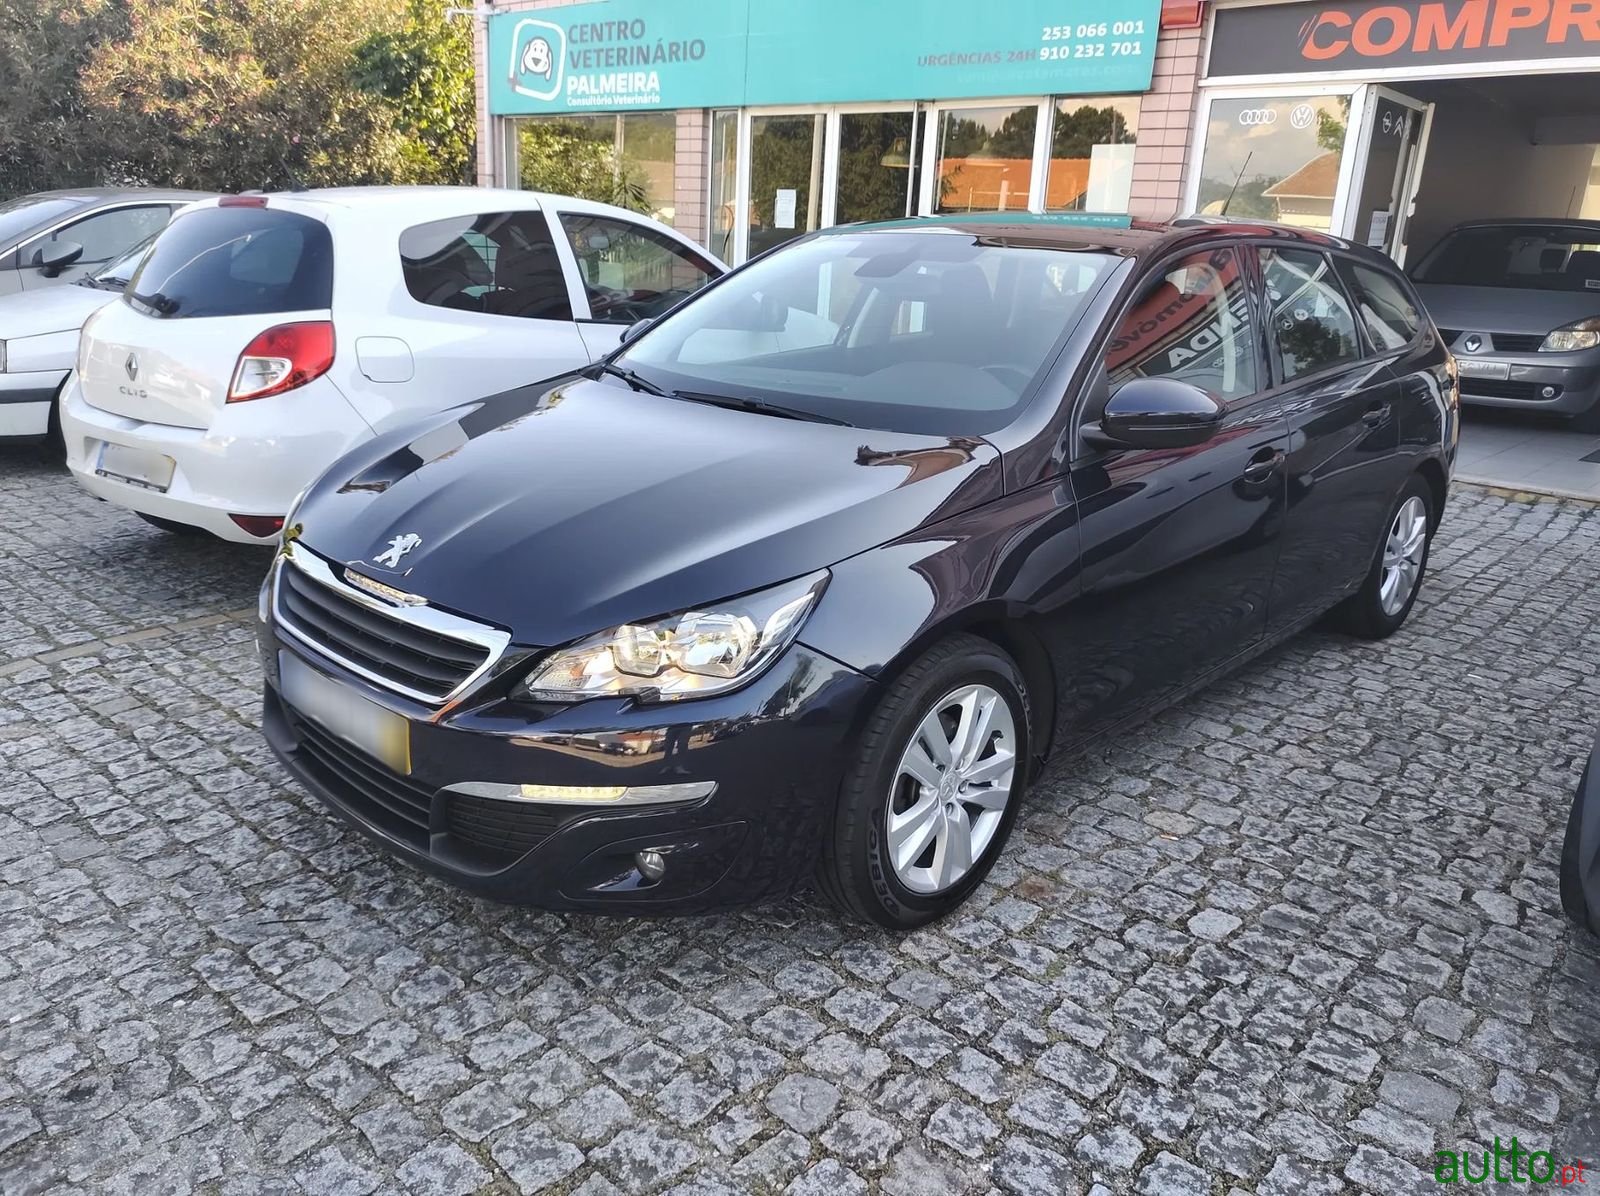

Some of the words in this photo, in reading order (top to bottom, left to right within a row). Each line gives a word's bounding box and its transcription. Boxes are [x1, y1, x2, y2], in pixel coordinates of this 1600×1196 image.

[568, 18, 646, 44] CENTRO
[1042, 26, 1071, 40] 253
[1076, 23, 1107, 38] 066
[1112, 20, 1144, 36] 001
[569, 37, 706, 69] VETERINÁRIO
[1007, 48, 1036, 63] 24H
[1040, 46, 1070, 60] 910
[1074, 43, 1105, 58] 232
[1111, 41, 1142, 56] 701
[566, 70, 661, 96] PALMEIRA
[567, 94, 612, 107] Consultório
[613, 92, 661, 105] Veterinário
[119, 386, 148, 399] CLIO
